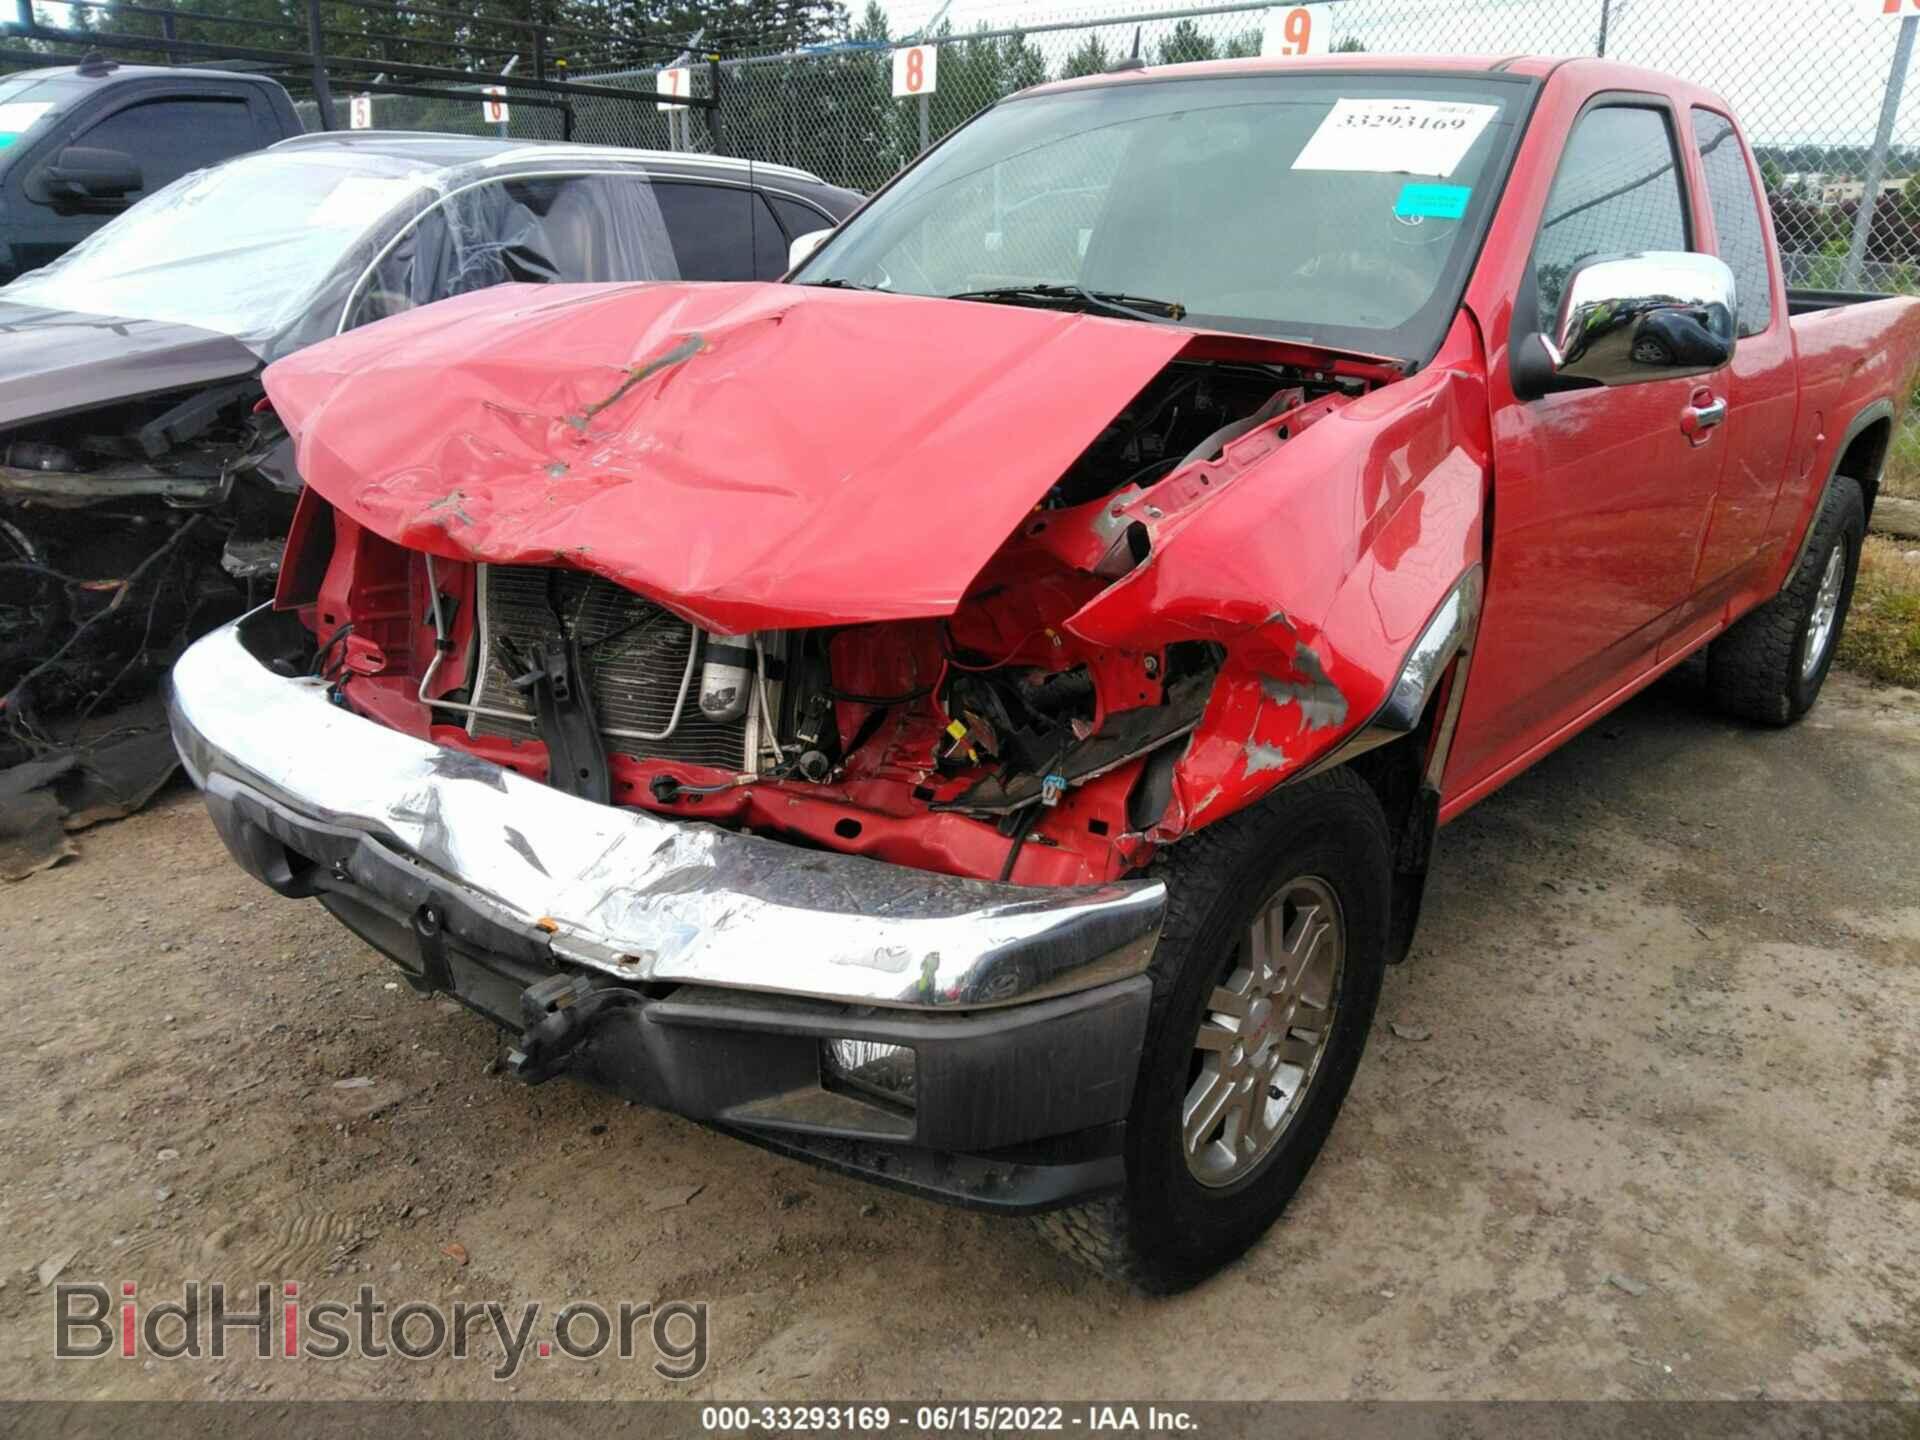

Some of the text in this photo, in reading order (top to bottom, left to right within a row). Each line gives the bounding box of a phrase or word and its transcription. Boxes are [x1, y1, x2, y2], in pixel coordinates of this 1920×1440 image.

[1282, 7, 1311, 55] 9
[668, 69, 679, 97] 7
[907, 48, 923, 92] 8
[356, 98, 365, 128] 5
[1336, 114, 1466, 130] 33293169
